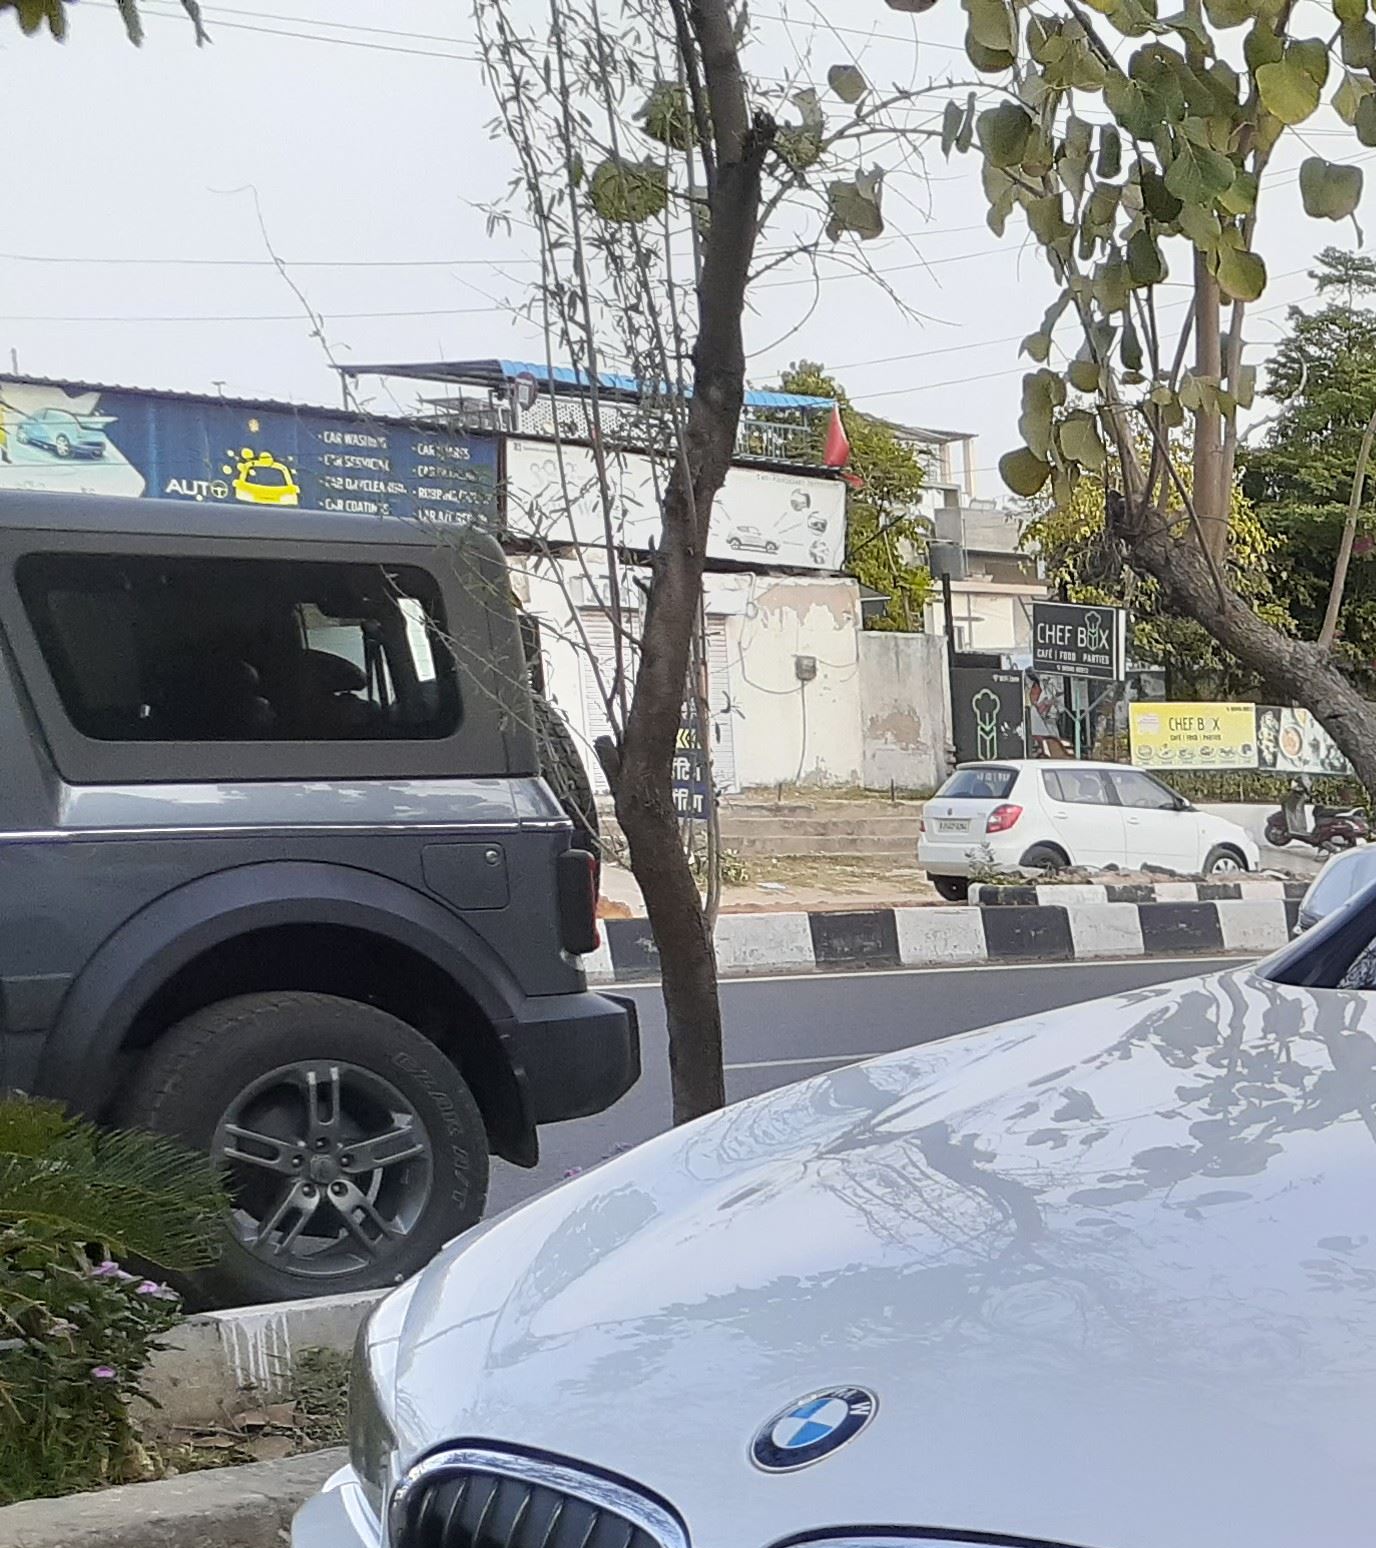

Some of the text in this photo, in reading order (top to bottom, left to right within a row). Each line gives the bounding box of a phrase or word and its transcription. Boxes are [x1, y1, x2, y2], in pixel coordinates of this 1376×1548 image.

[345, 500, 389, 515] COATINS
[1037, 622, 1073, 646] CHEF
[1168, 717, 1195, 731] CHEF
